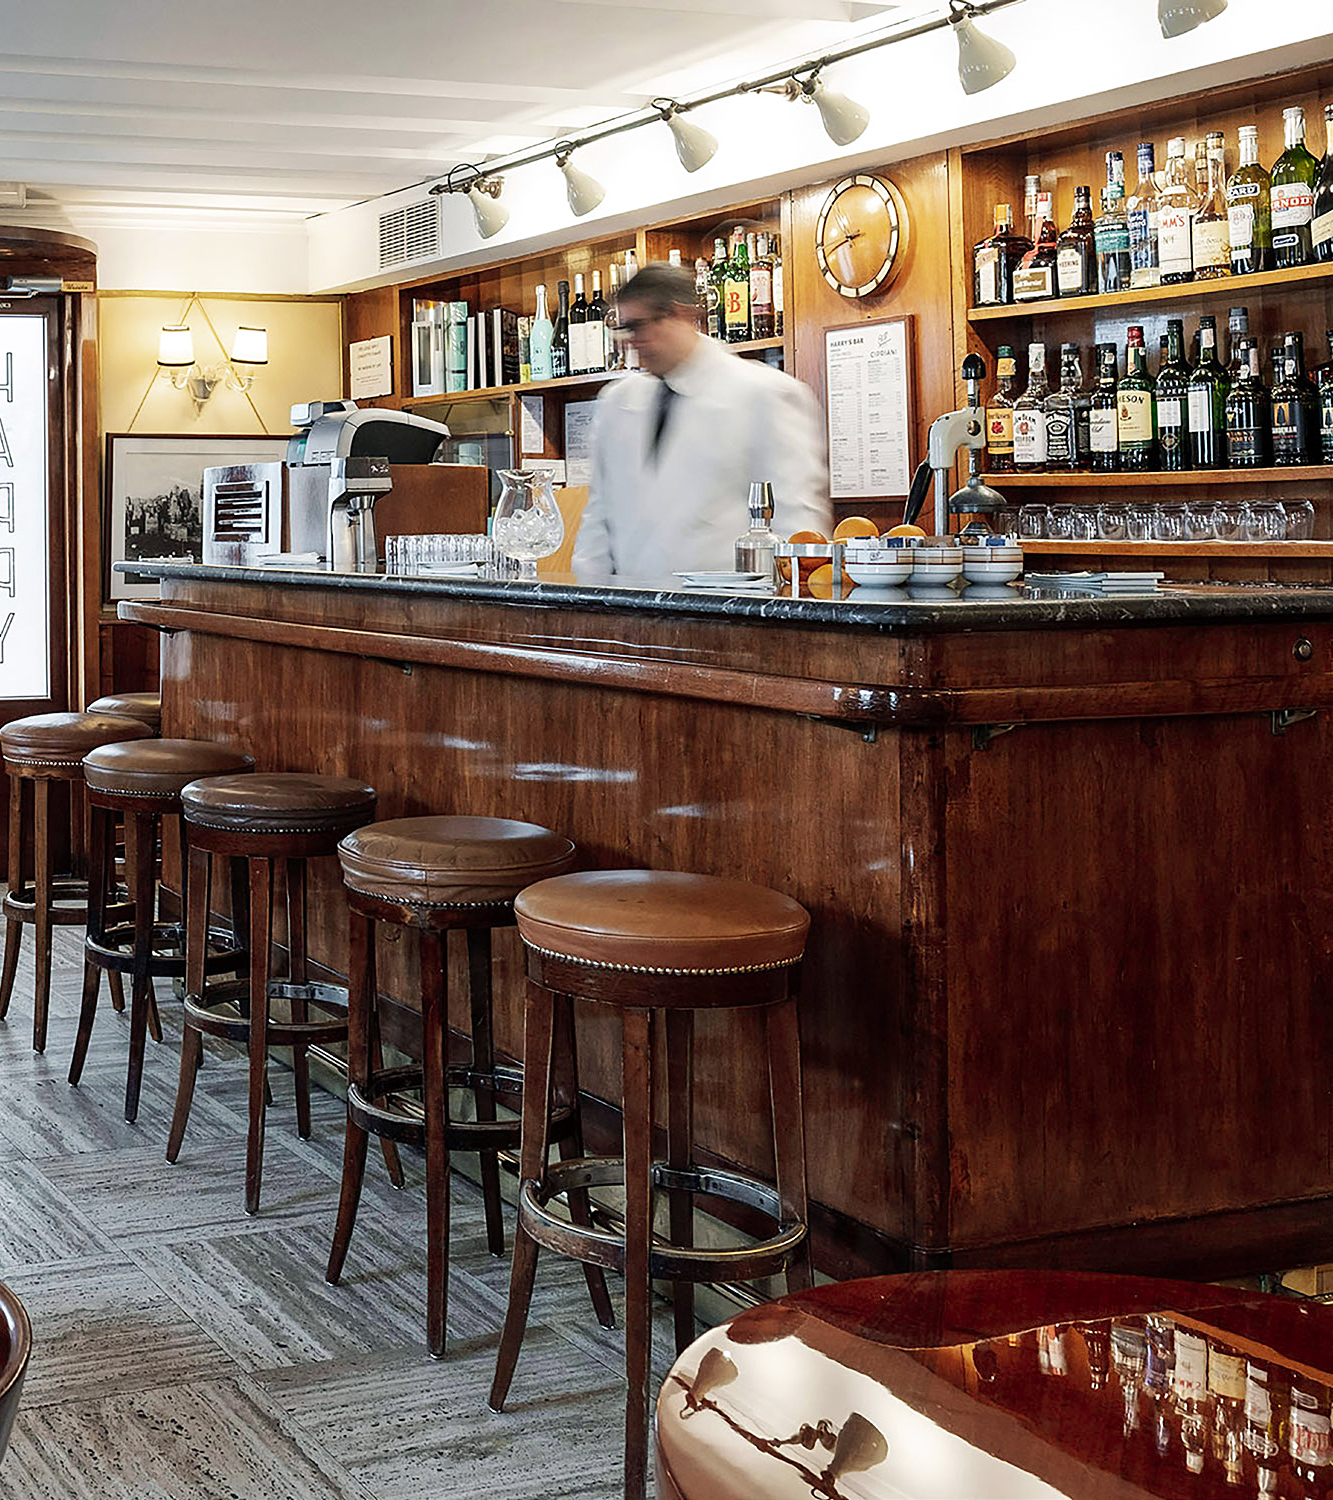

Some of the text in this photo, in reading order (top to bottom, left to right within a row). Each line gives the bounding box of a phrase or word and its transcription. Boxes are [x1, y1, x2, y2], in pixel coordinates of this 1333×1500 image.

[1272, 196, 1311, 209] RNOD
[1162, 214, 1186, 228] MM'S
[1120, 394, 1145, 405] ESON
